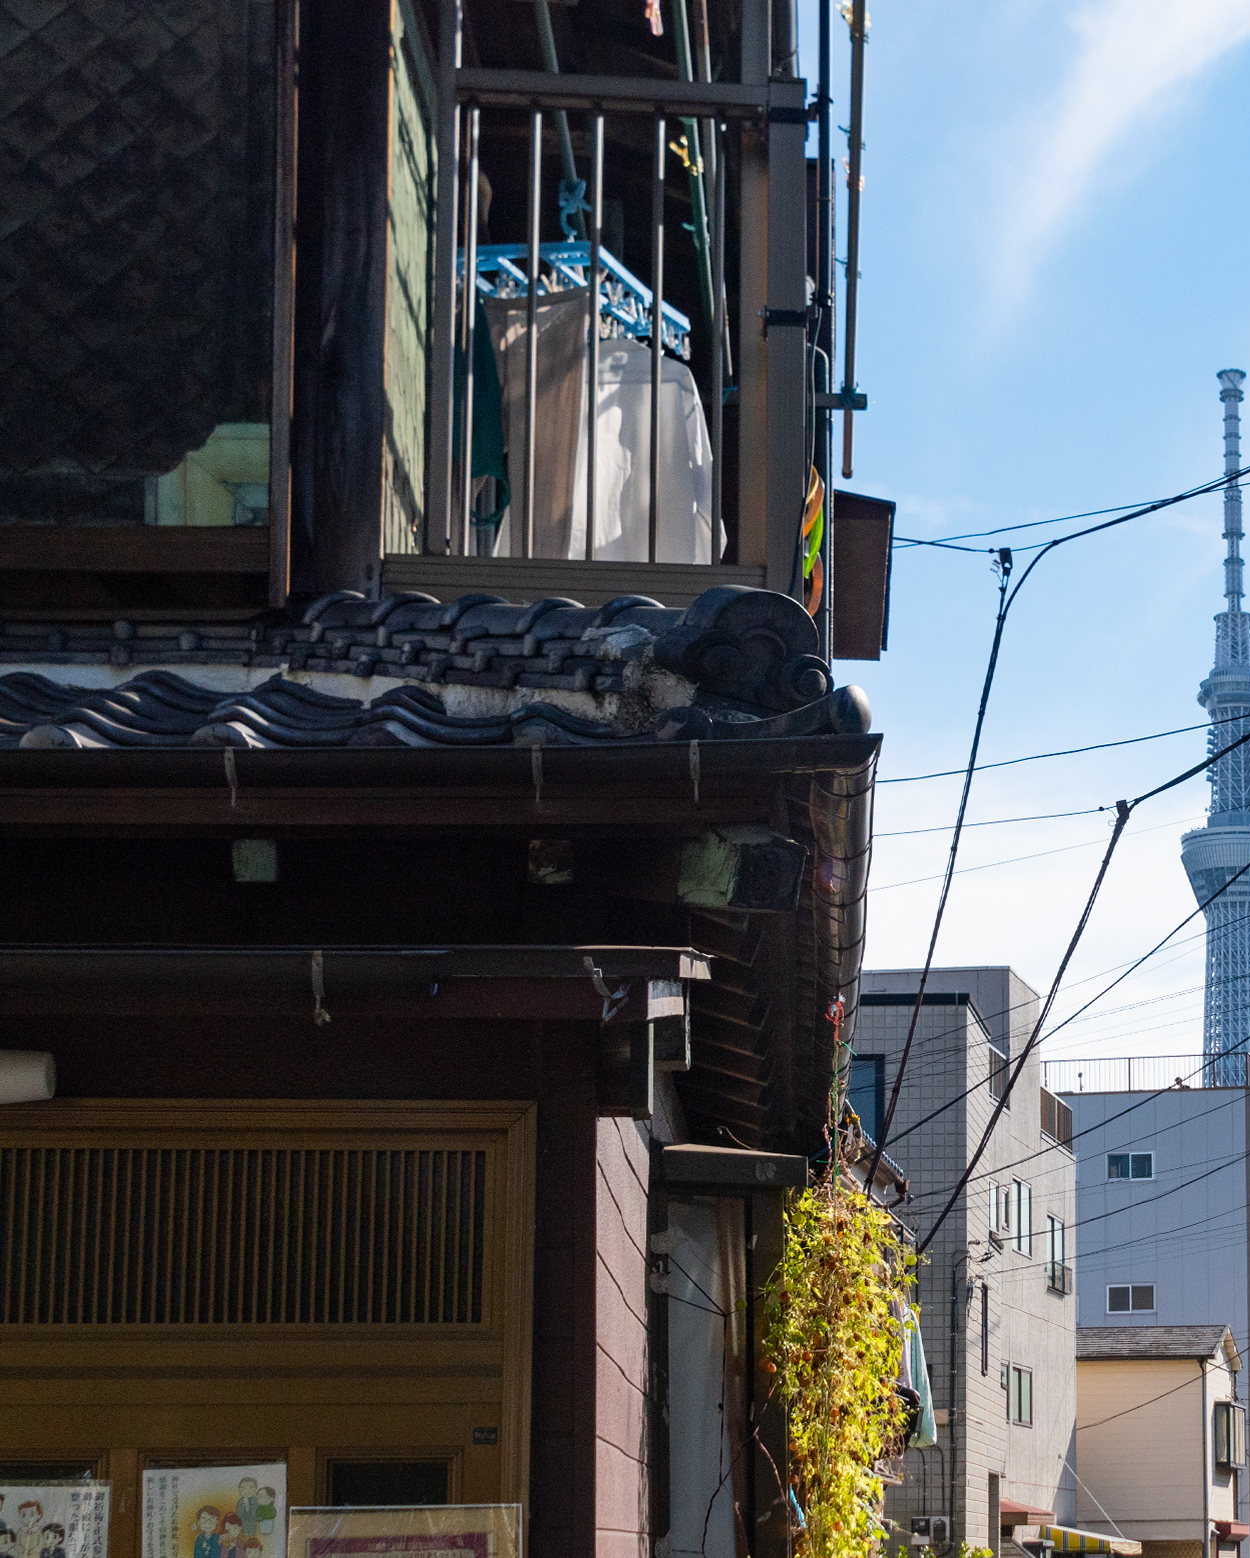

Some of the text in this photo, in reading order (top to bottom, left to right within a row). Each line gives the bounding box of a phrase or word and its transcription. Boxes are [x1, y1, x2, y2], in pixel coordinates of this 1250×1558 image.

[93, 1492, 105, 1558] 御祈祷・正式参
